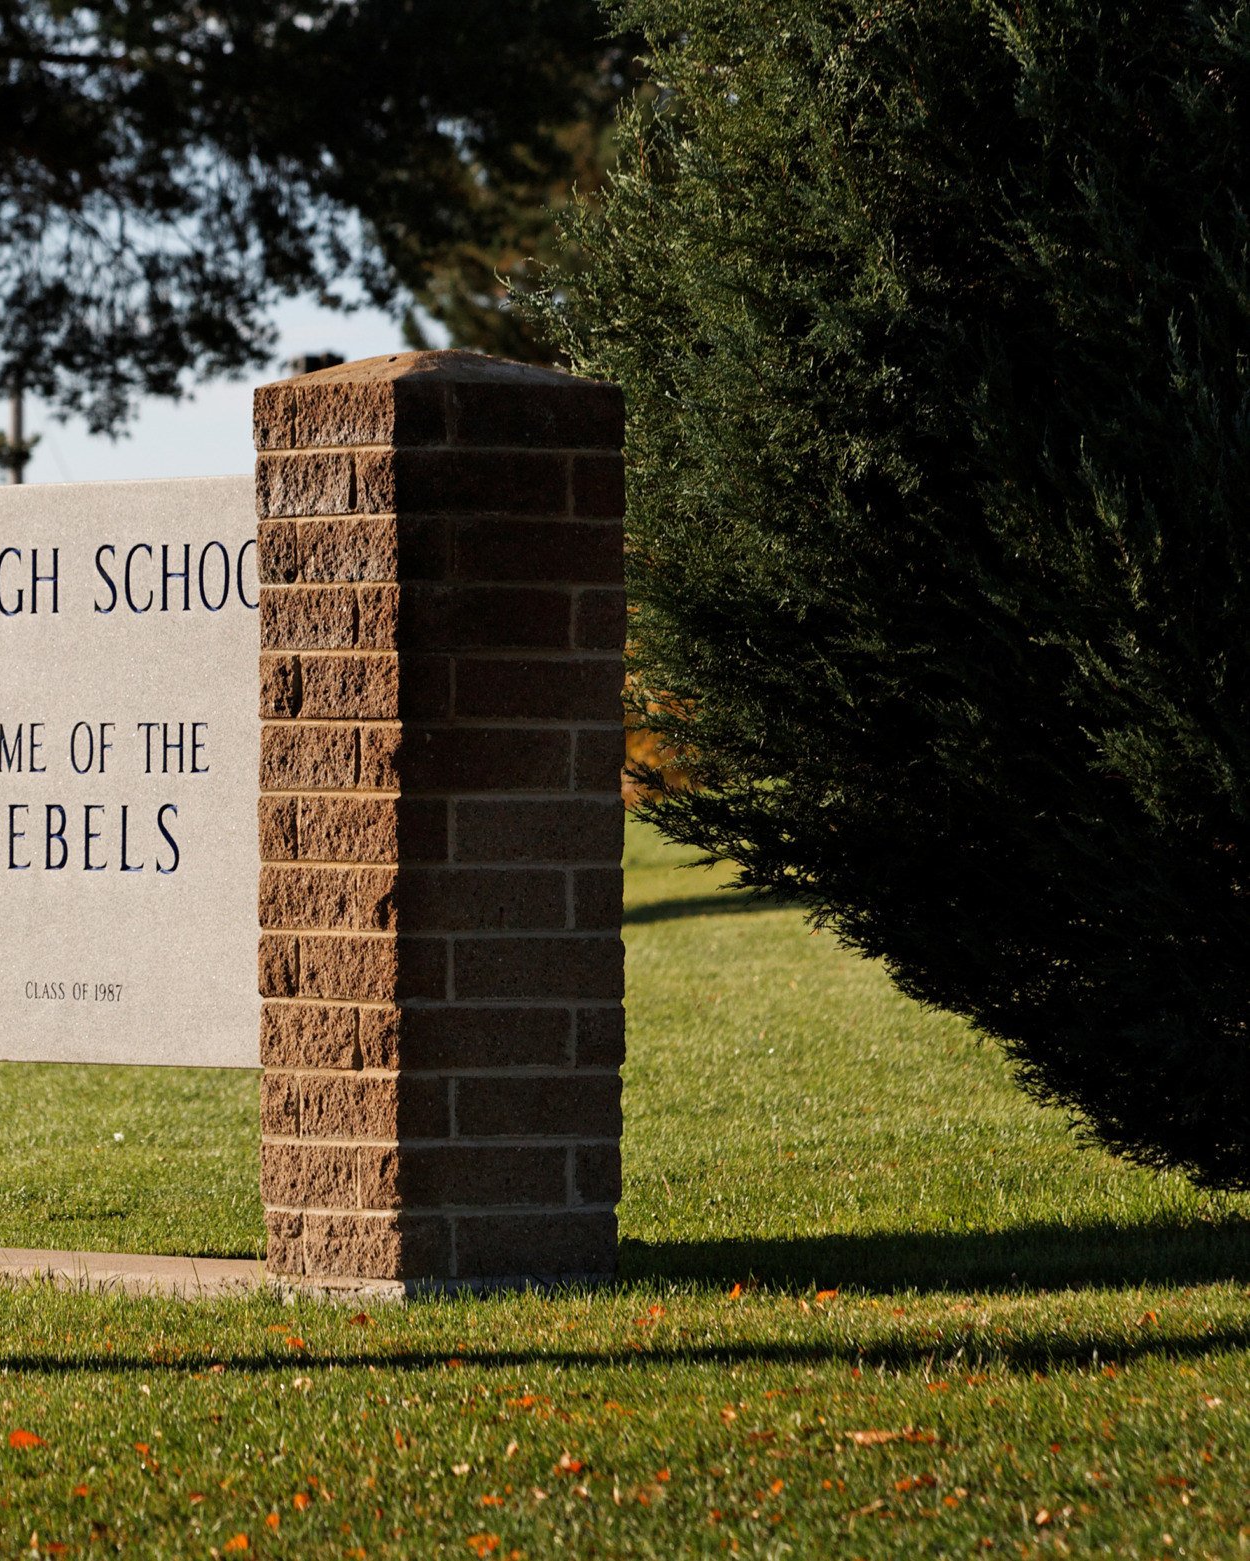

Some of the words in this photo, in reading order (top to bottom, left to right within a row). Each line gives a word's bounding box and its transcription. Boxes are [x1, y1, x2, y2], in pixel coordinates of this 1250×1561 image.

[94, 539, 260, 614] SCHOO
[70, 721, 116, 774] OF
[137, 722, 210, 773] THE
[25, 980, 66, 1000] CLASS
[72, 982, 89, 1001] OF
[94, 983, 124, 1002] 1987
